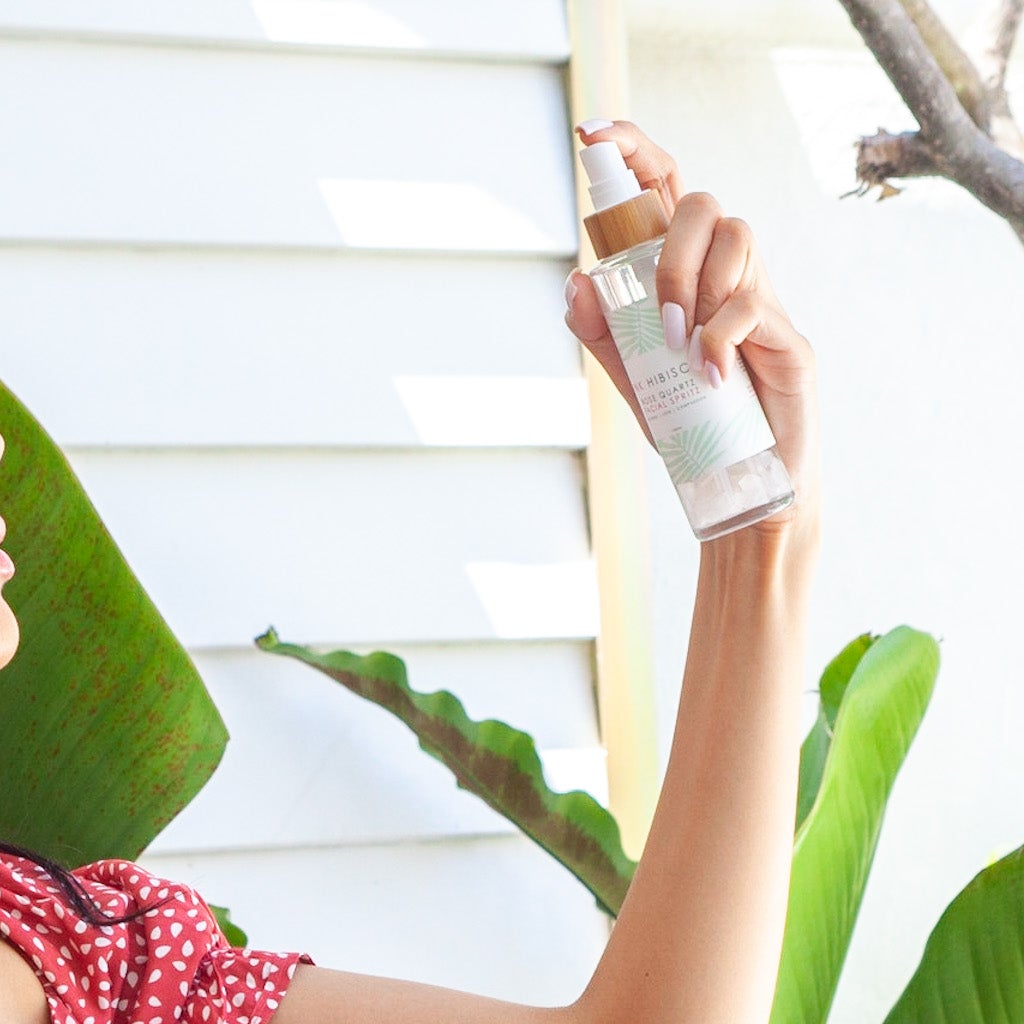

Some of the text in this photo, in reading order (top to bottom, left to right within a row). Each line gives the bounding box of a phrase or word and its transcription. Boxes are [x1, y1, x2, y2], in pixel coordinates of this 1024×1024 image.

[646, 362, 690, 387] HIBISC
[659, 378, 695, 399] QUARTZ
[669, 386, 701, 405] SPRITZ
